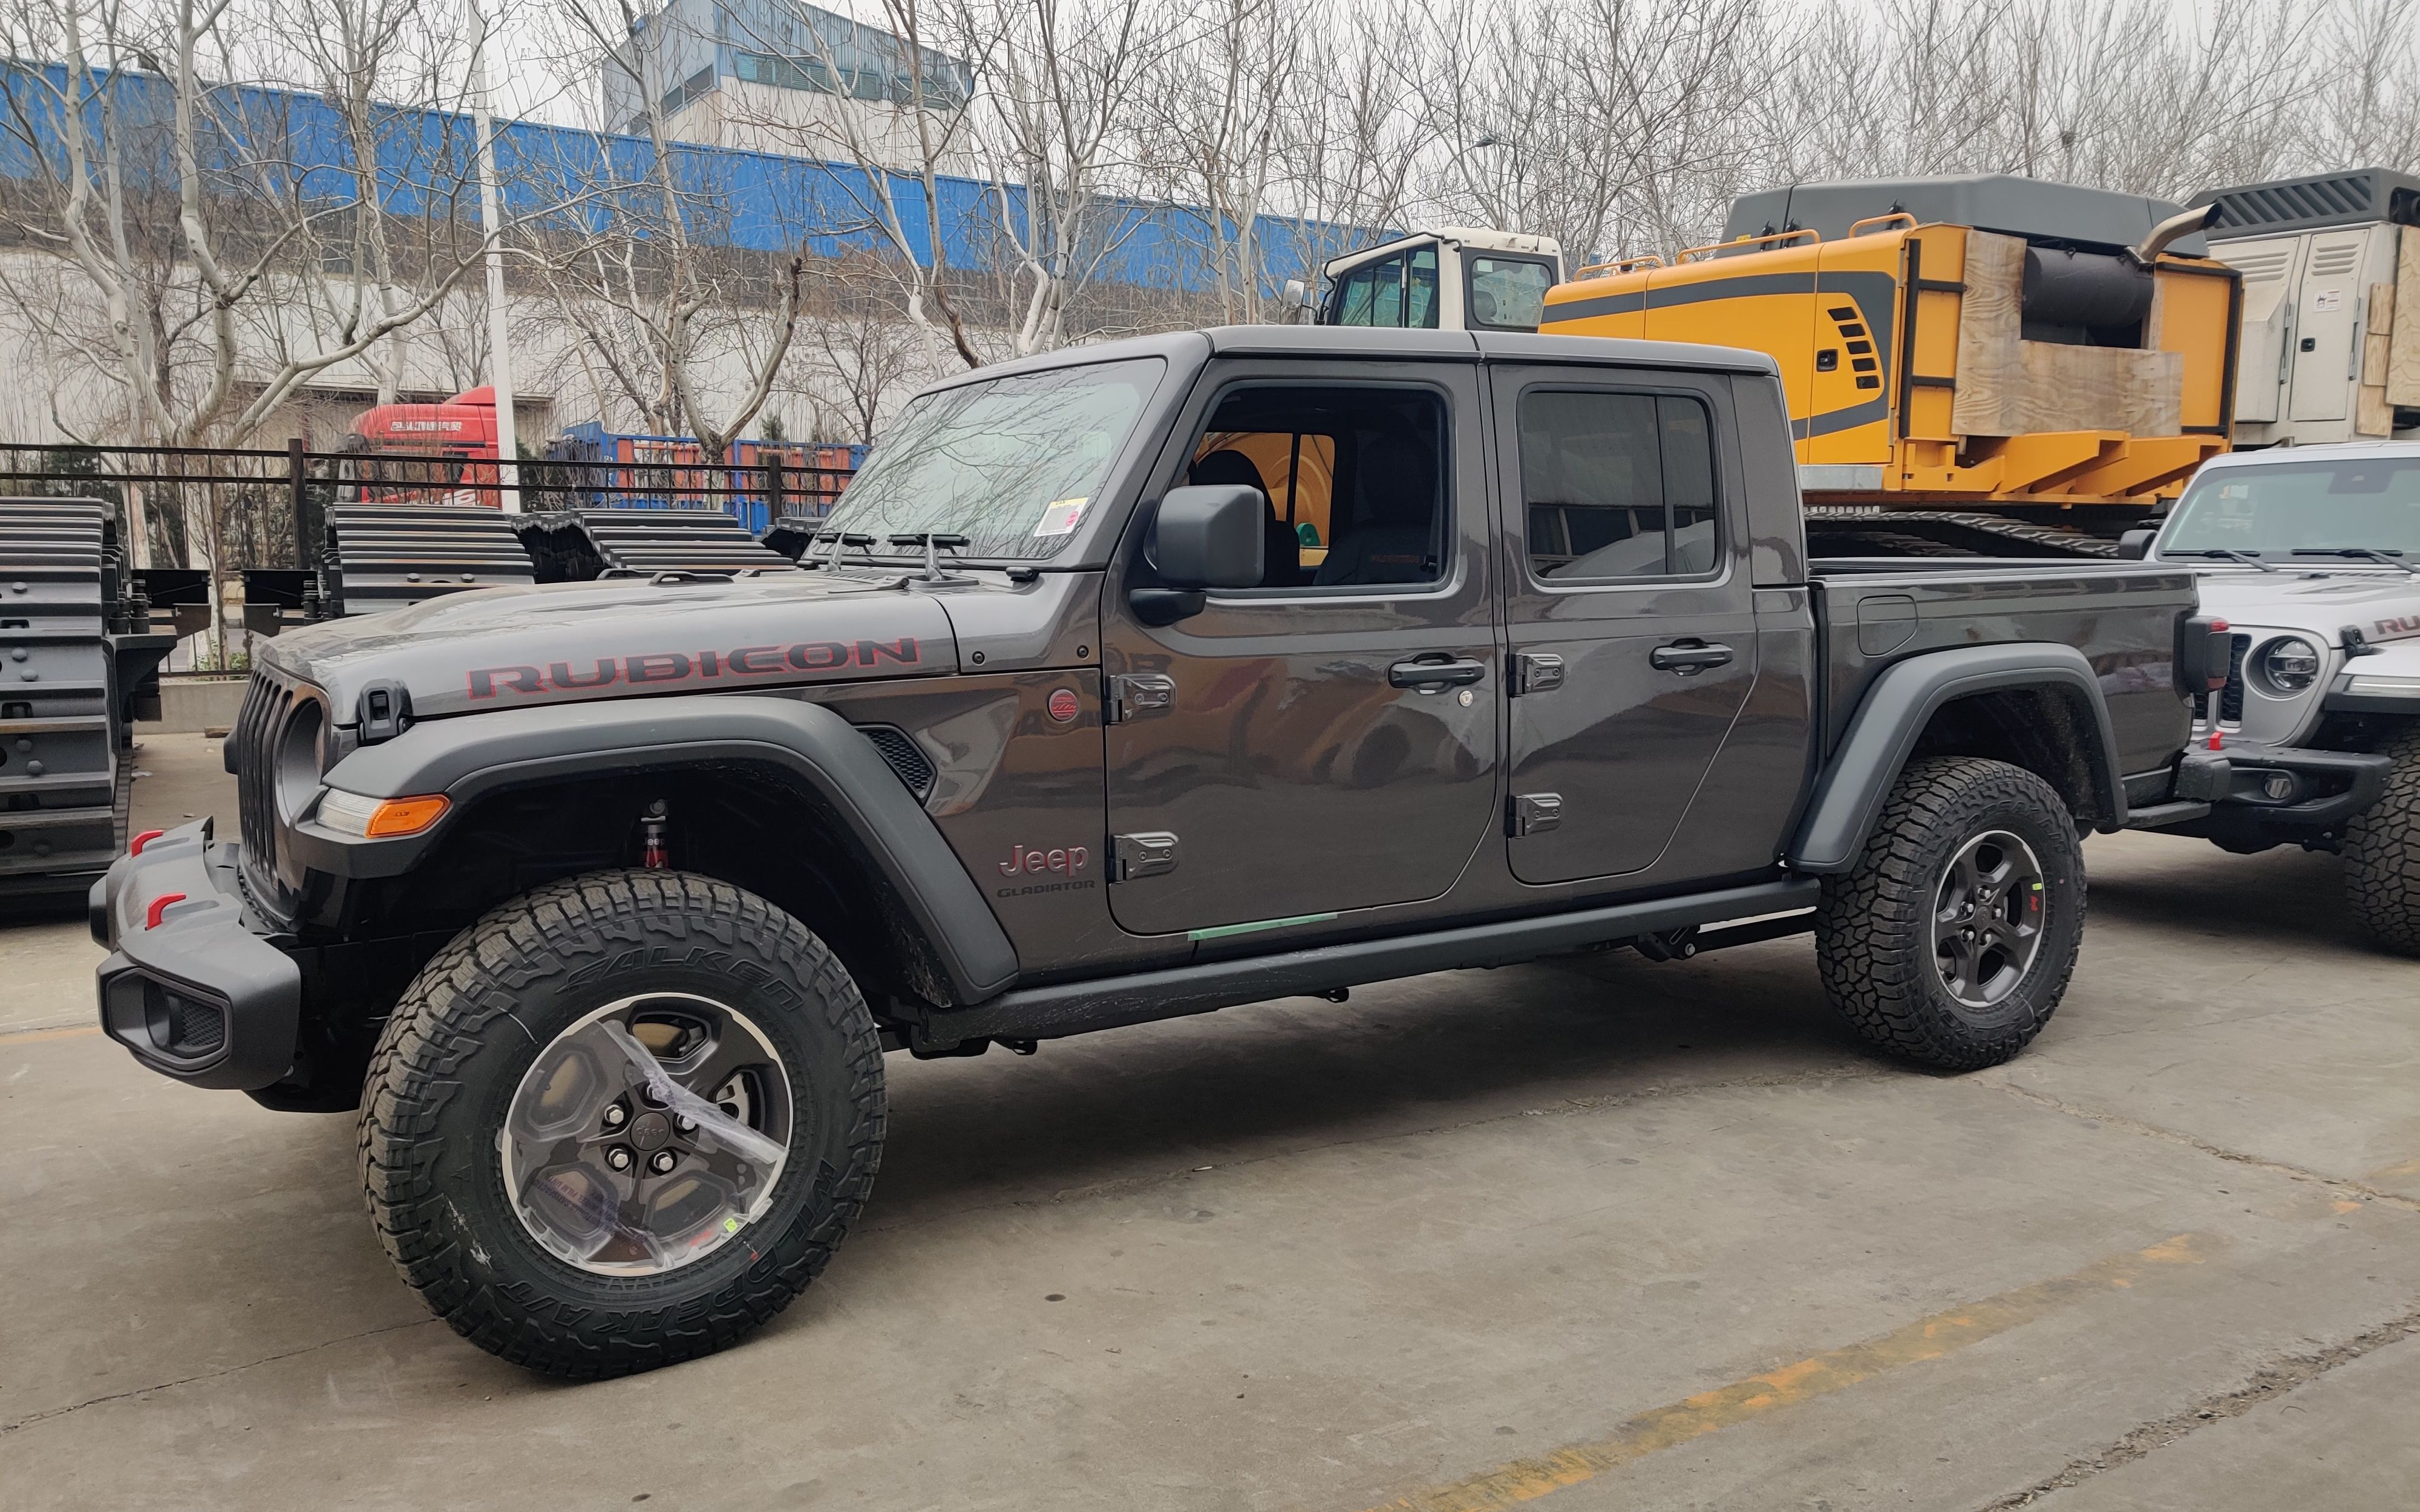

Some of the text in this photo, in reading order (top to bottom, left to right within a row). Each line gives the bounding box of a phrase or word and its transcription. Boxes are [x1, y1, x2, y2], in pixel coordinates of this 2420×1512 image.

[467, 637, 921, 700] RUBICON
[999, 845, 1089, 878] Jeep
[997, 880, 1095, 898] GLADIATOR
[554, 947, 805, 1011] FALKEN
[560, 1183, 578, 1199] FILM
[495, 1156, 839, 1333] WILDPEAK A/T
